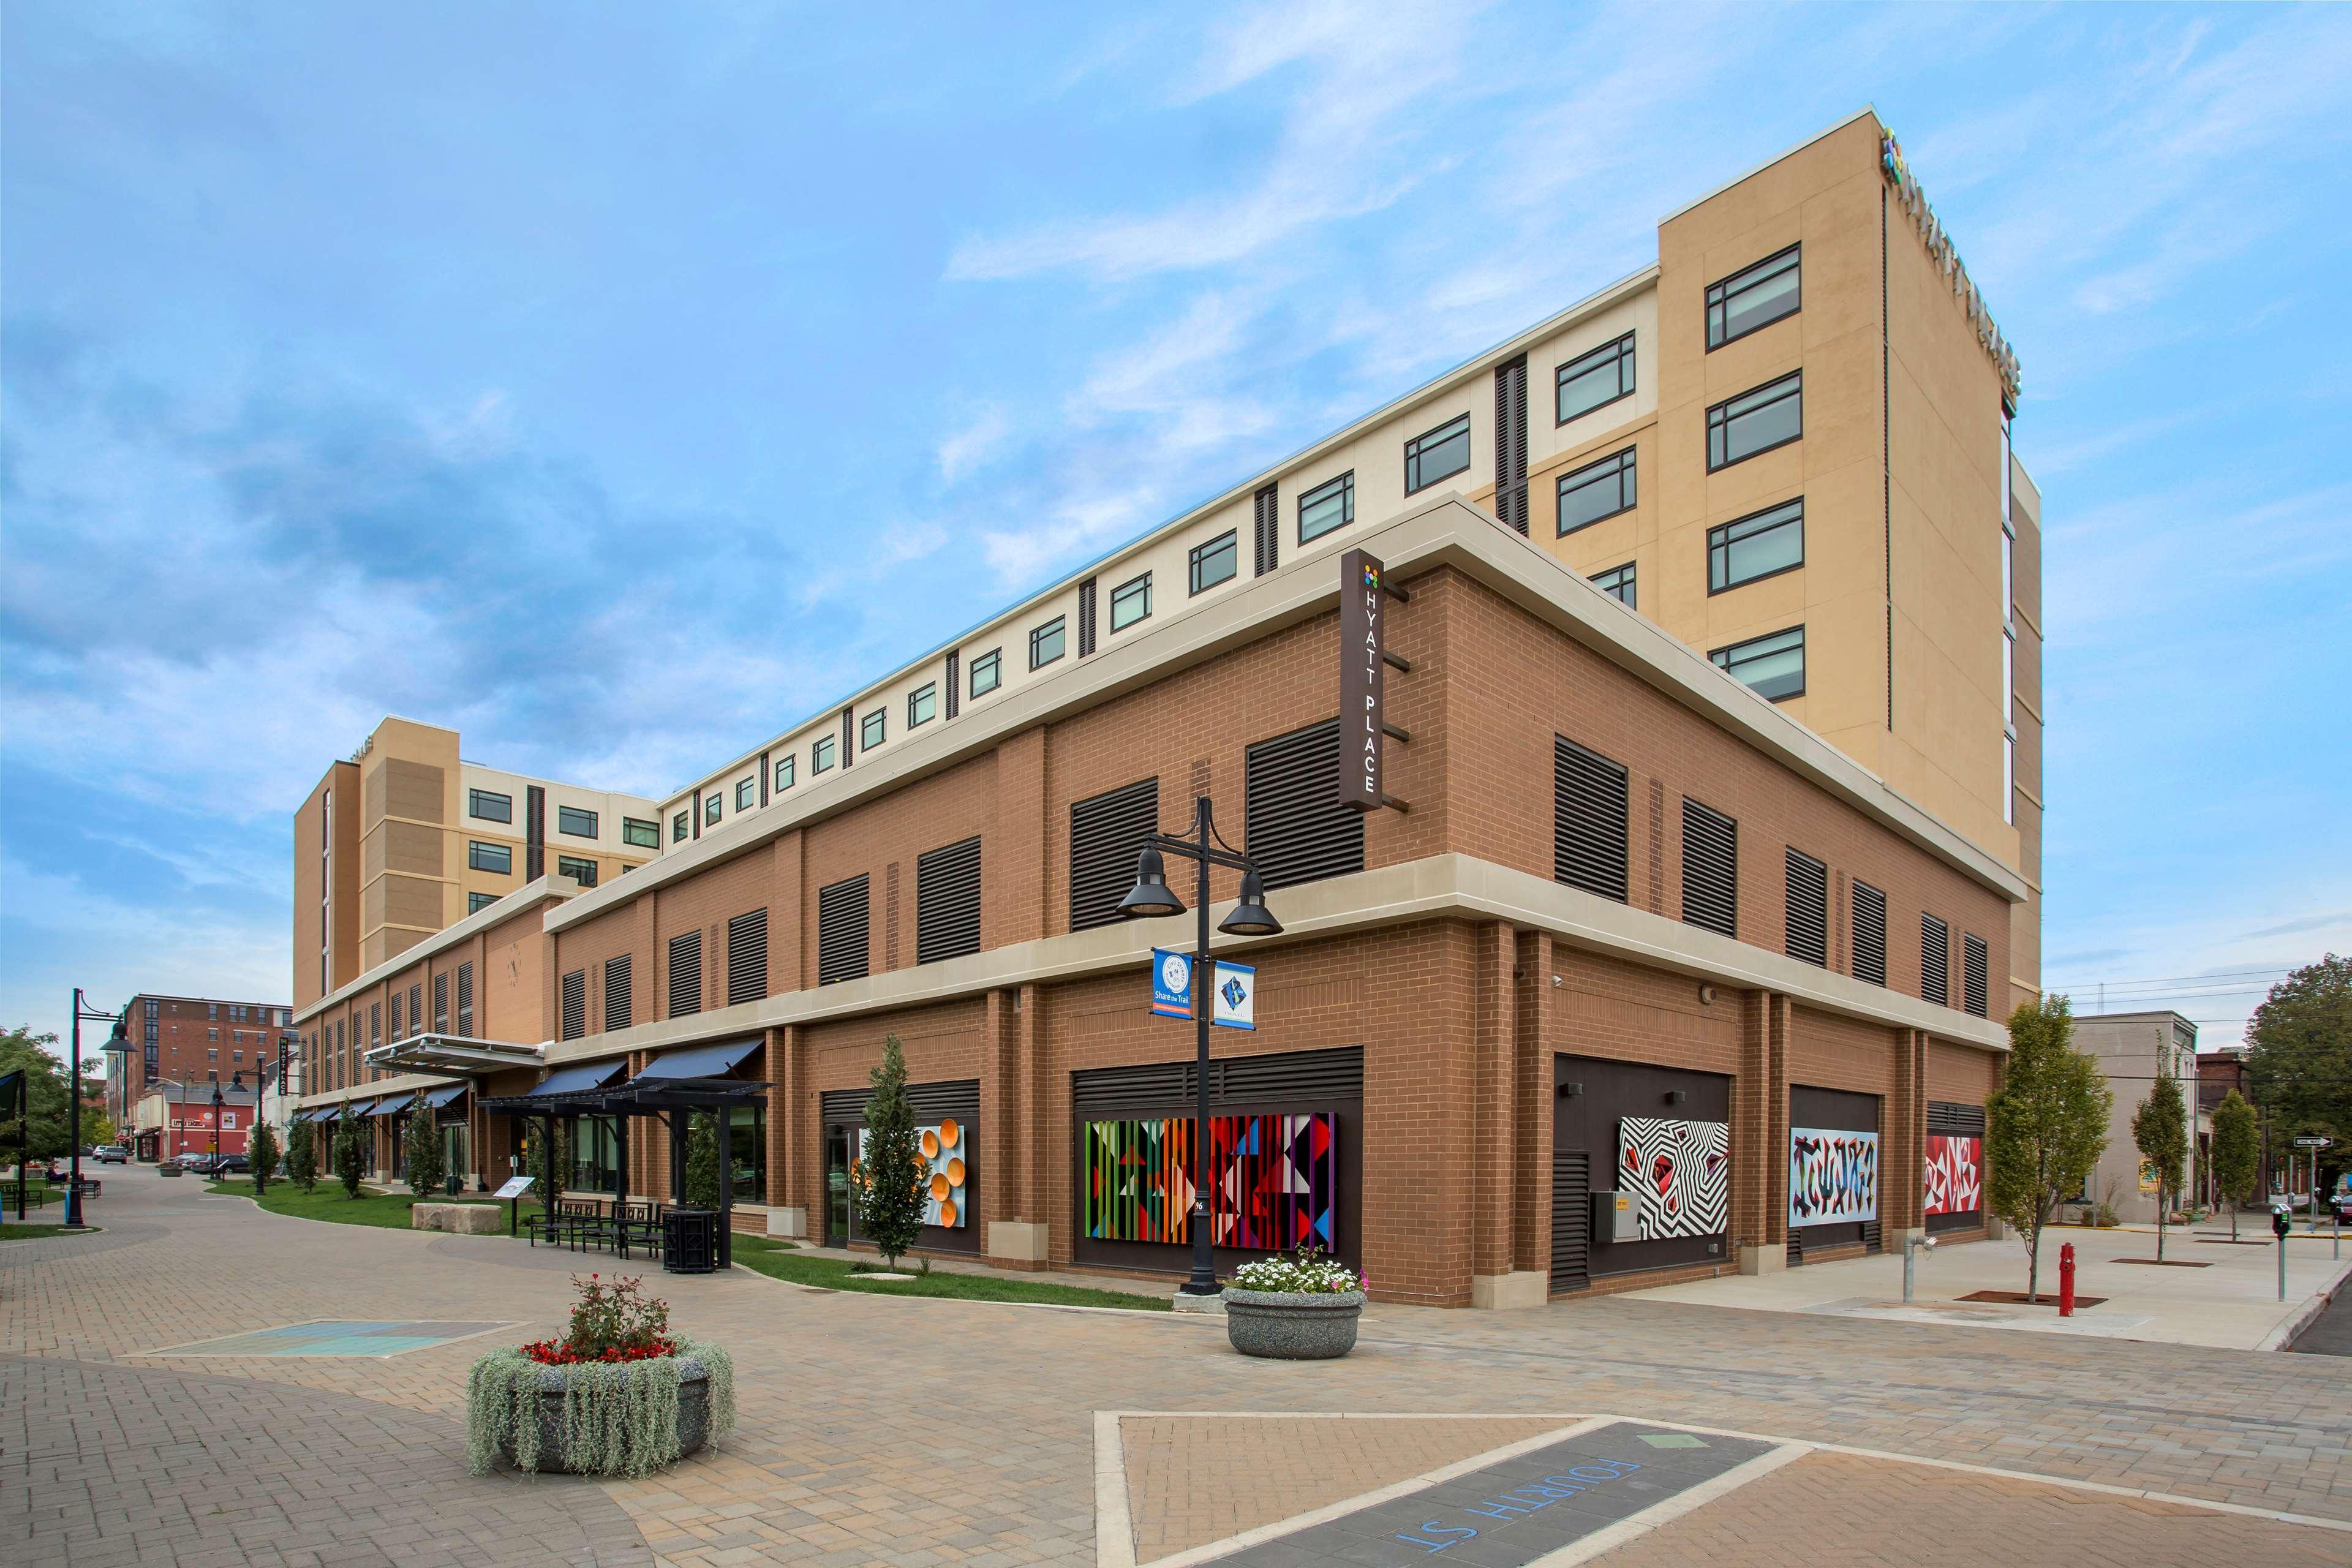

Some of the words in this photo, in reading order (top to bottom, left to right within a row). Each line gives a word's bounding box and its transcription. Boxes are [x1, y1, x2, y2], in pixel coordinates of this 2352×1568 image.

[1365, 590, 1376, 685] HYATT
[1365, 695, 1375, 793] PLACE
[1155, 990, 1170, 1001] Share
[1178, 995, 1189, 1004] Trail
[1464, 1458, 1642, 1520] FOURTH
[1395, 1520, 1479, 1554] ST
